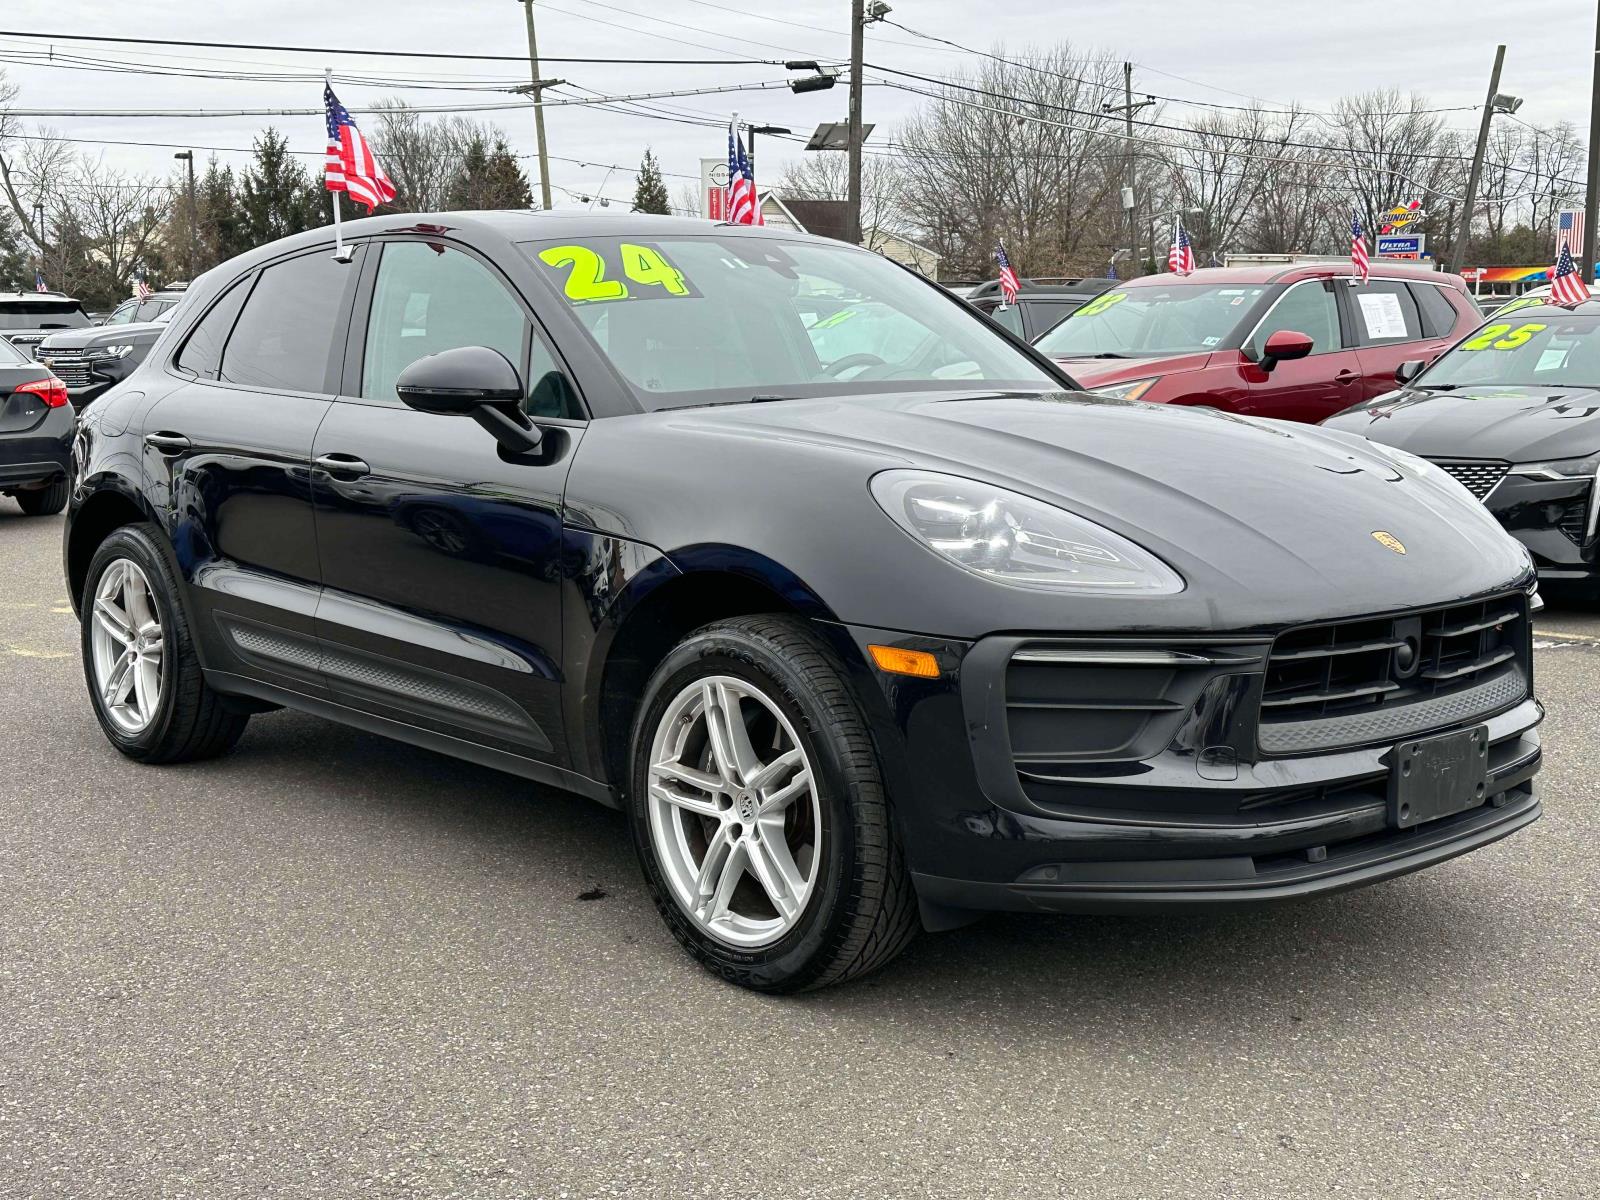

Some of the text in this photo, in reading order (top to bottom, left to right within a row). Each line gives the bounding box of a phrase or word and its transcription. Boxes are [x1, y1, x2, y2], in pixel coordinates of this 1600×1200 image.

[1381, 212, 1419, 223] SUNOCO
[1380, 242, 1410, 250] ULTRA
[538, 244, 689, 301] 24
[1460, 324, 1547, 351] 25
